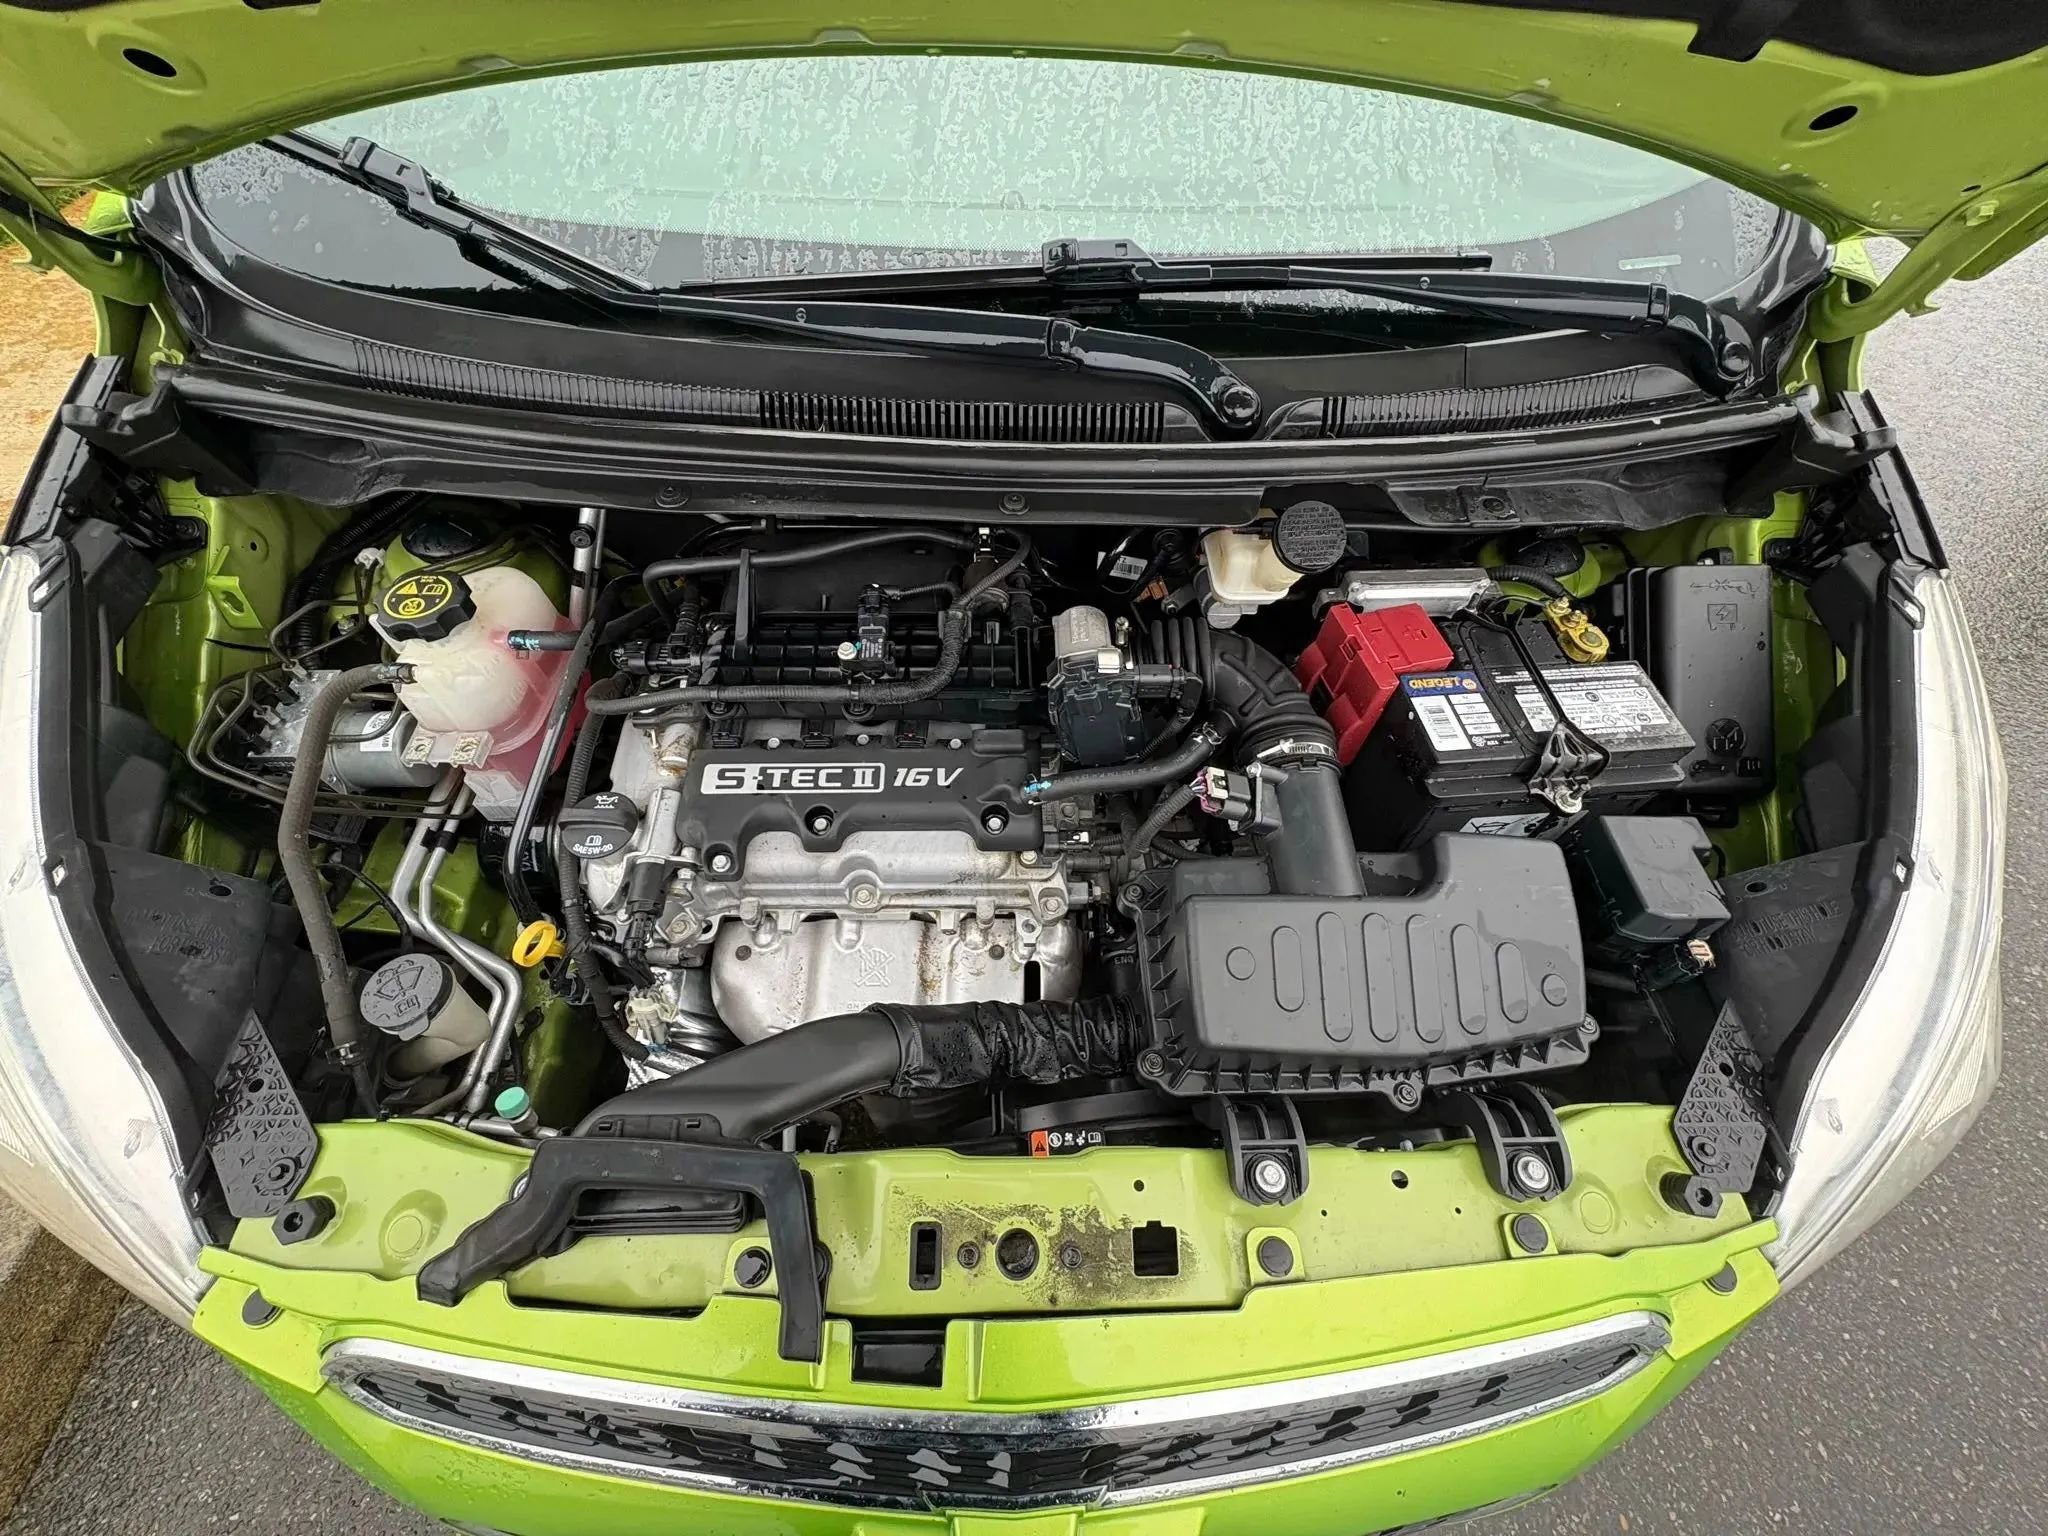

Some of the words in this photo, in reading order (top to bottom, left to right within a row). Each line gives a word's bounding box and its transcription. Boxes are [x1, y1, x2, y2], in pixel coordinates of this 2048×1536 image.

[1409, 676, 1461, 690] LEGEND
[714, 767, 843, 790] S-TEC
[893, 767, 965, 788] 16V
